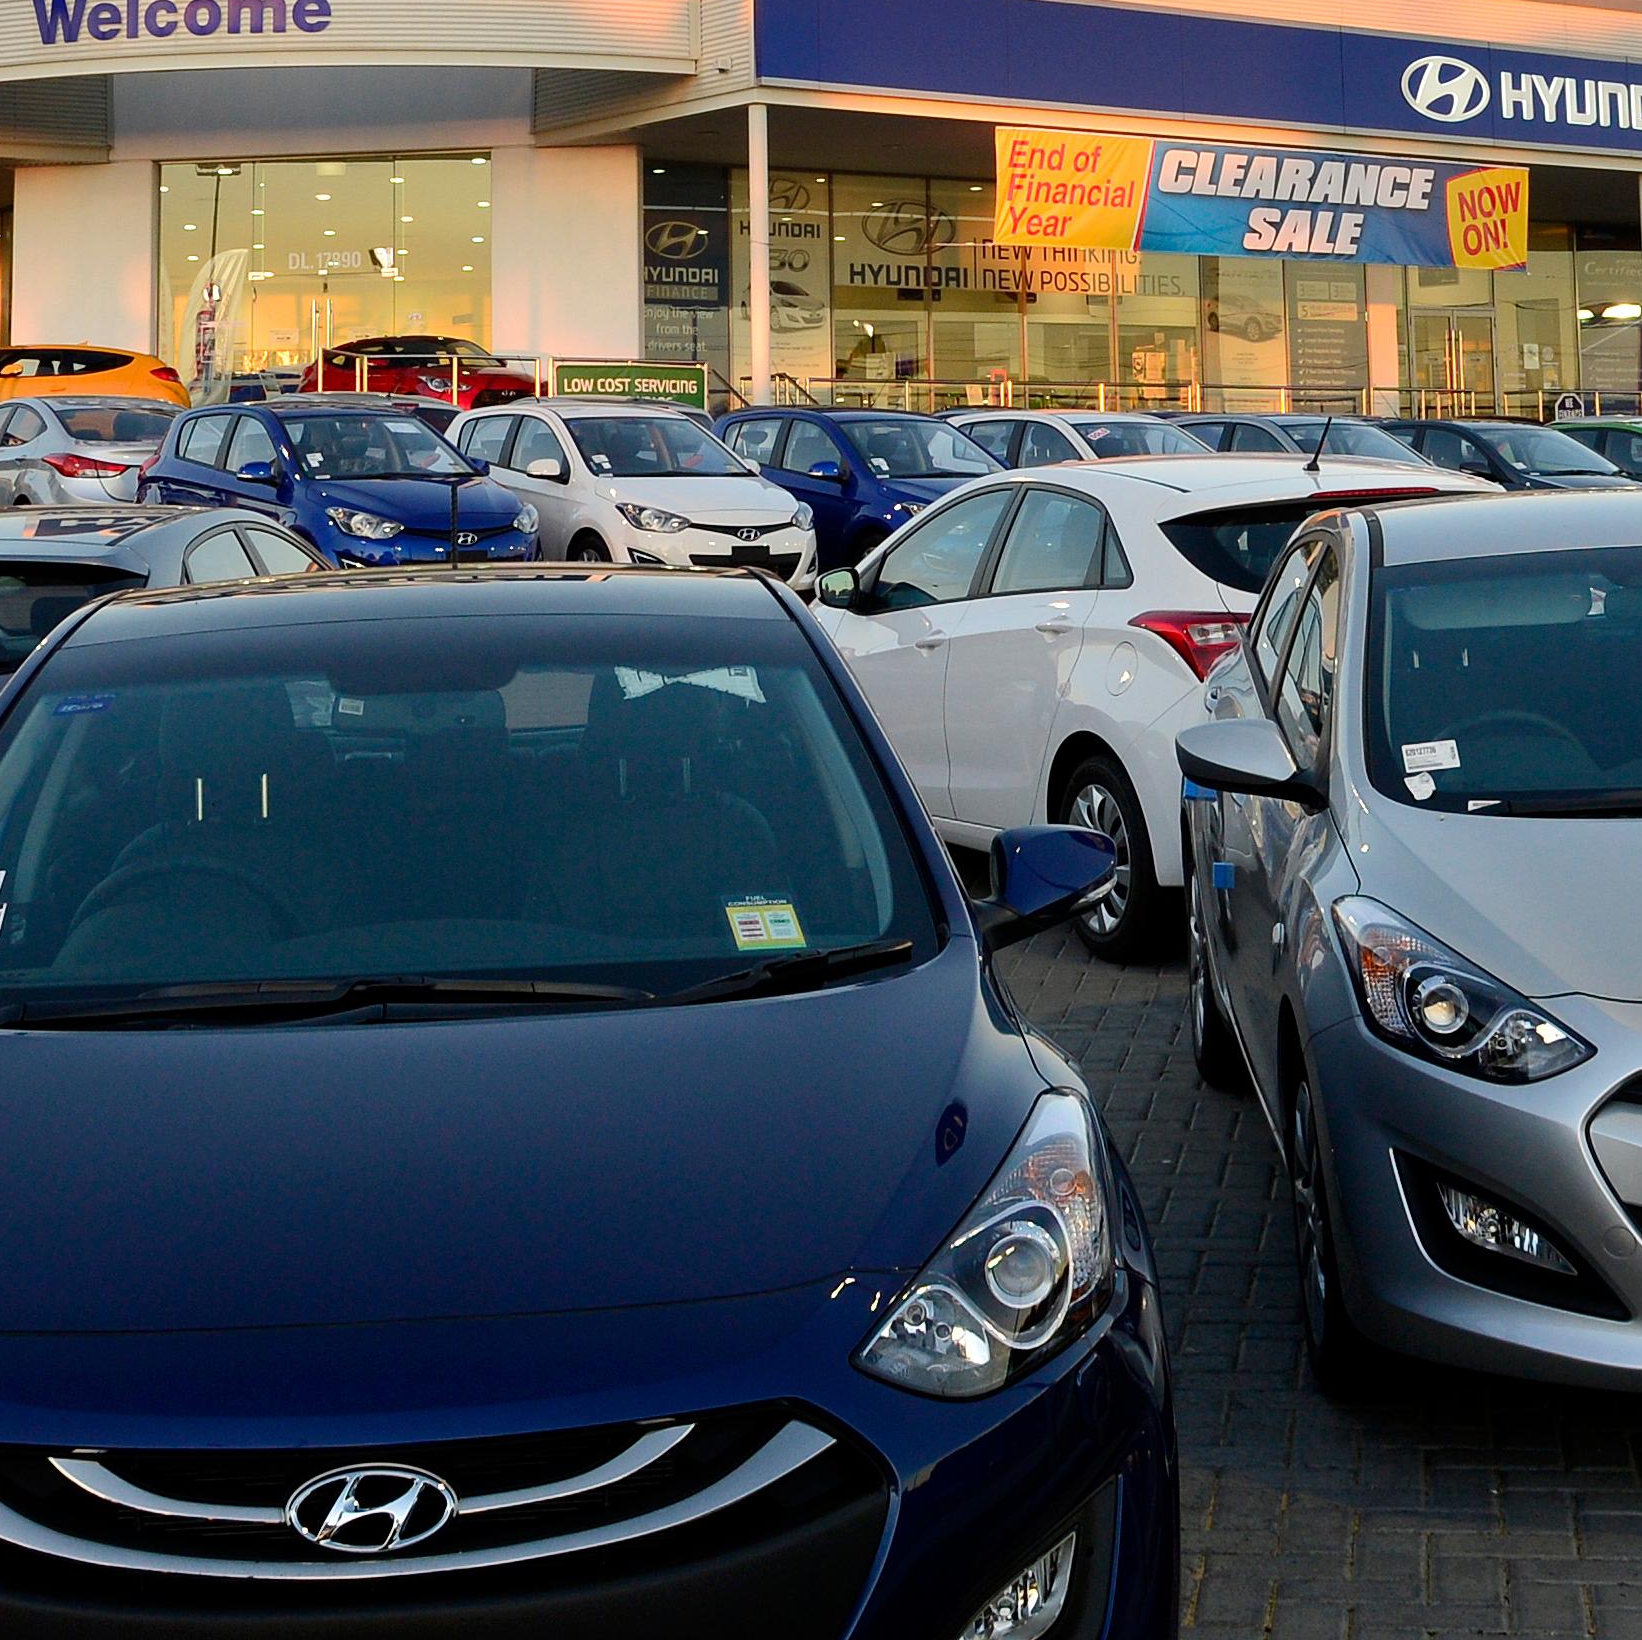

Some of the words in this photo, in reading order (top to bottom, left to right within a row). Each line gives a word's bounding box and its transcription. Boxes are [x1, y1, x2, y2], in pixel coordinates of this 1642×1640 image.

[1008, 139, 1066, 171] End
[1073, 143, 1102, 171] of
[1006, 171, 1135, 209] Financial
[1156, 149, 1434, 210] CLEARANCE
[1458, 181, 1521, 218] NOW
[740, 220, 820, 238] HUNDAI
[1008, 206, 1074, 238] Year
[1242, 207, 1364, 255] SALE
[982, 239, 1033, 261] NEW
[1462, 220, 1509, 256] ON!
[769, 248, 810, 273] 30
[849, 262, 968, 289] HYUNDAI
[983, 269, 1033, 291] NEW
[646, 287, 708, 299] FINANCE
[656, 322, 679, 334] from
[563, 378, 594, 393] LOW
[596, 378, 631, 393] COST
[634, 378, 698, 394] SERVICING
